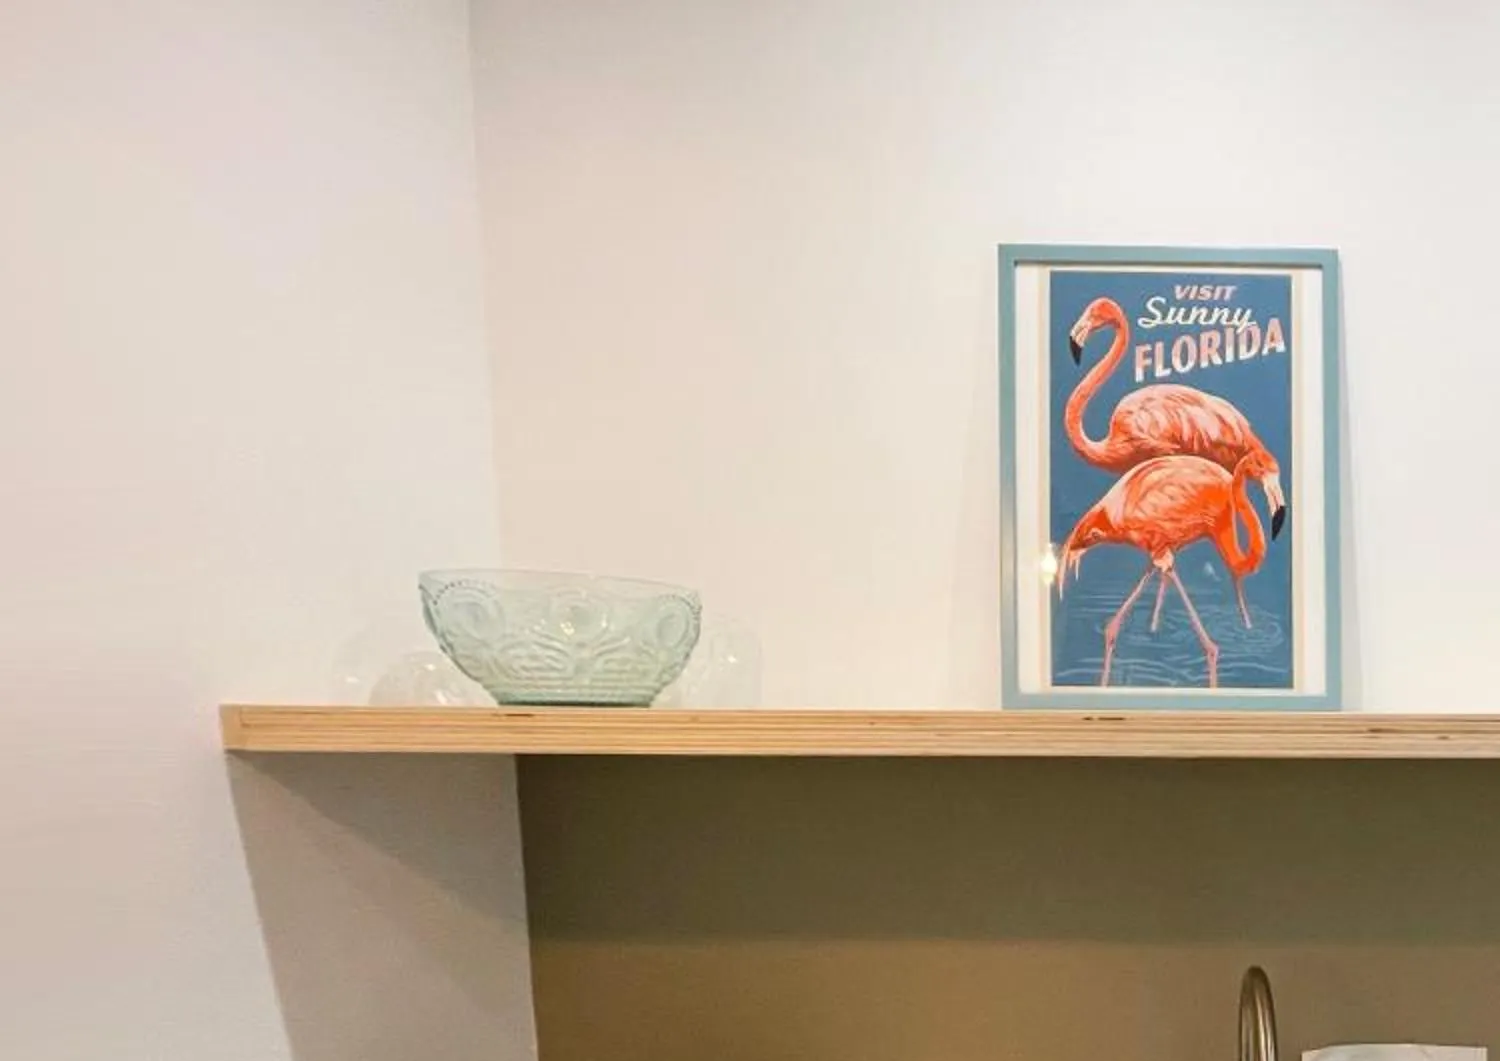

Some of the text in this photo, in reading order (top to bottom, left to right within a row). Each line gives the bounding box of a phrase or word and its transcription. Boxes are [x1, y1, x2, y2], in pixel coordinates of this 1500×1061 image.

[1173, 284, 1238, 300] VISIT
[1137, 296, 1257, 334] Sunny
[1134, 317, 1286, 382] FLORIDA
